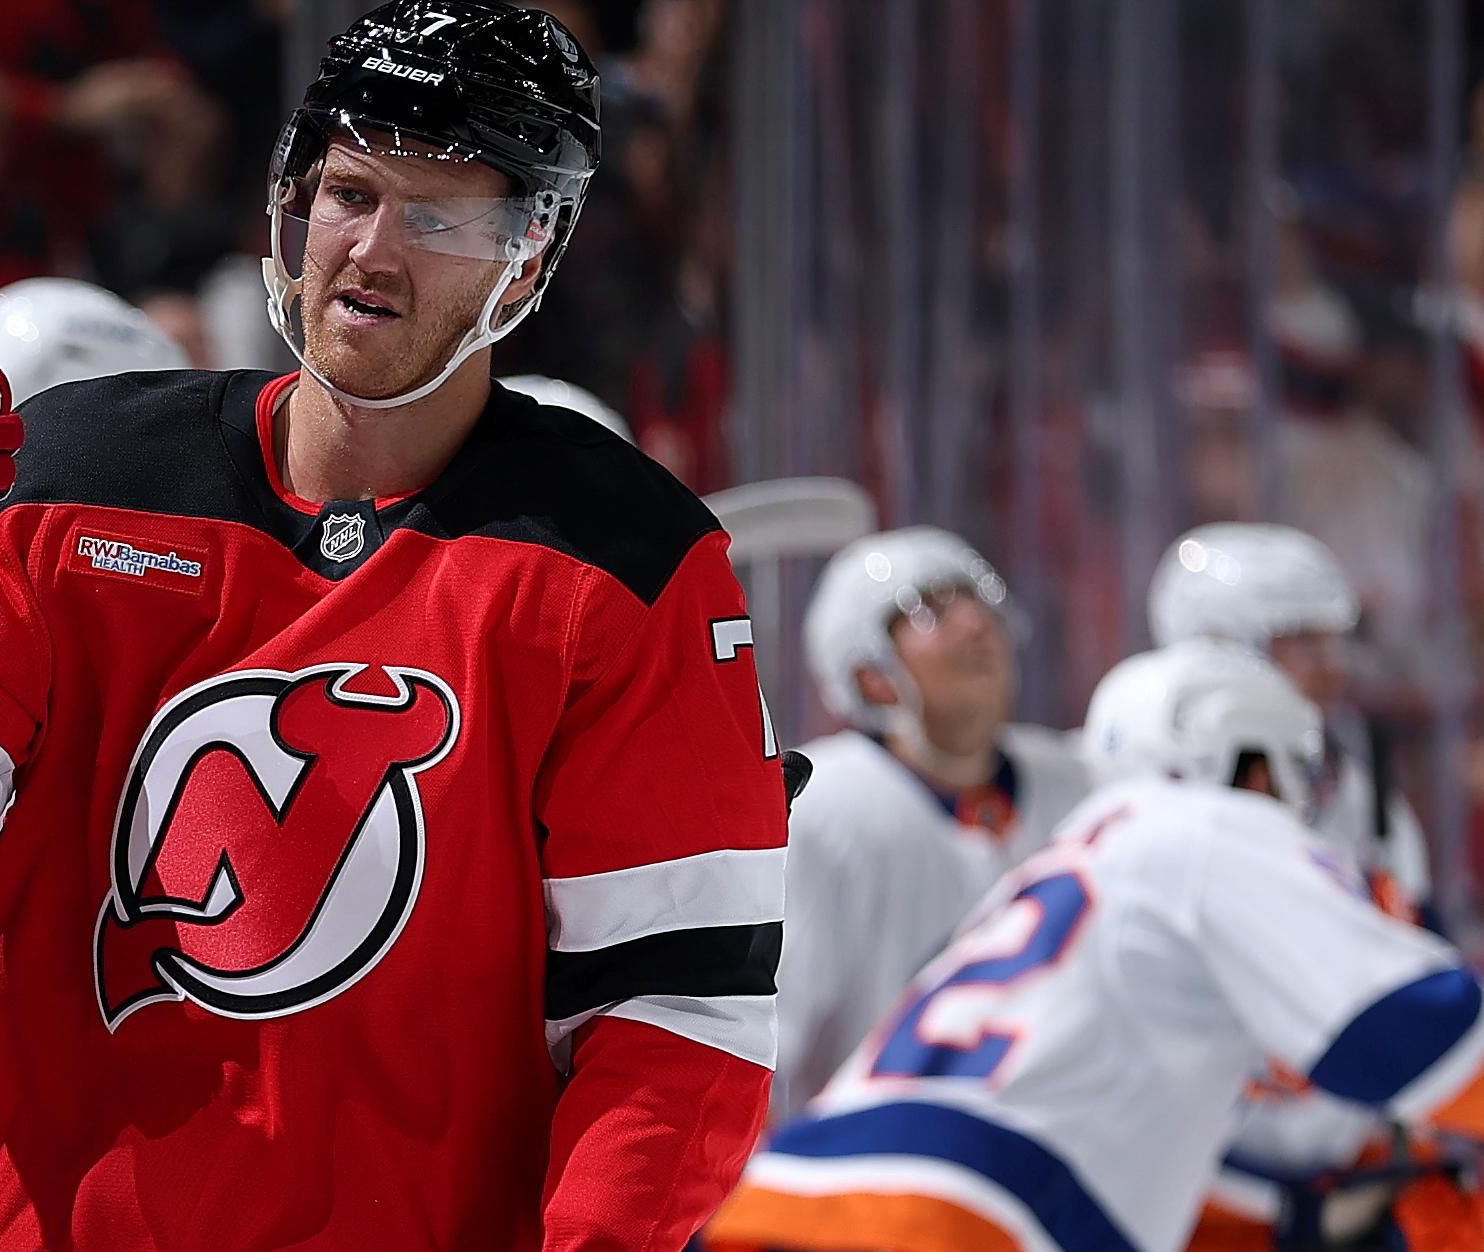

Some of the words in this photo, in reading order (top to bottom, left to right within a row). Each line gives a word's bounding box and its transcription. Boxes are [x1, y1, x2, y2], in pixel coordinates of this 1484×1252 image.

[420, 11, 458, 38] 7
[330, 526, 357, 551] NHL
[92, 555, 145, 576] HEALTH
